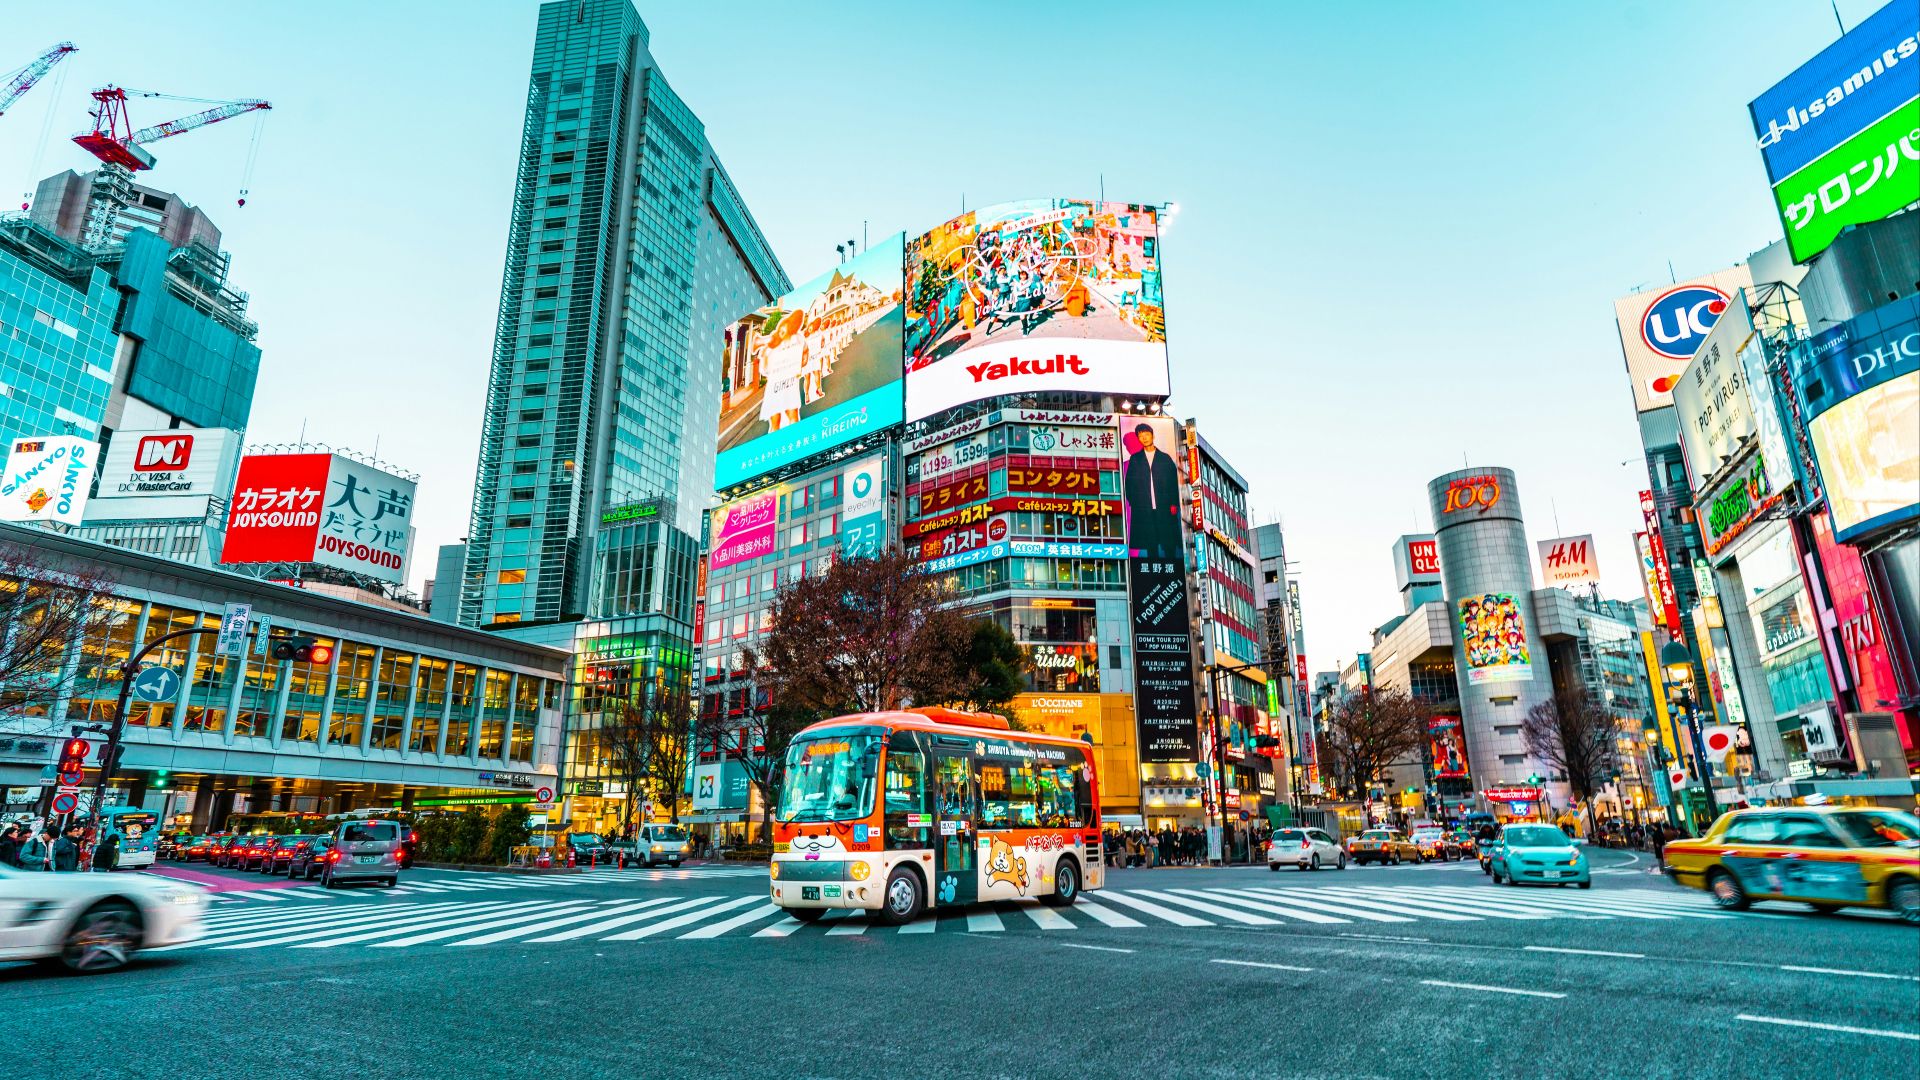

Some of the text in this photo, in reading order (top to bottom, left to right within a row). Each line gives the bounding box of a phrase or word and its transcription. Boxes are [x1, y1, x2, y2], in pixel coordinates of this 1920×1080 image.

[1757, 31, 1920, 149] Hisamits
[1650, 299, 1727, 344] UC
[1811, 330, 1849, 358] Channel
[1695, 342, 1721, 389] 星野源
[1852, 333, 1920, 379] DHC
[965, 354, 1090, 384] Yakult
[1713, 372, 1740, 412] VIRUS
[821, 412, 868, 439] KIREIMO
[1021, 411, 1113, 424] しゃぶしゃぶバイキング
[912, 419, 982, 450] しゃぶしゃぶバイキング
[1060, 432, 1114, 449] しゃぶ葉
[1709, 432, 1719, 449] NOW
[1719, 424, 1727, 437] ON
[139, 440, 187, 466] DC
[955, 443, 988, 465] 1,599円
[2, 446, 67, 496] SANKYO
[130, 473, 147, 482] DC
[149, 472, 171, 481] VISA
[907, 463, 919, 475] 9F
[923, 456, 952, 476] 1,199円
[57, 444, 88, 515] SANKYO
[118, 482, 191, 491] DC MasterCard
[1008, 470, 1096, 488] コンタクト
[237, 487, 321, 511] カラオケ
[327, 473, 411, 521] 大声
[847, 497, 878, 513] eyecity
[922, 478, 987, 510] プライス
[1442, 481, 1501, 515] 109
[740, 497, 774, 517] 品川スキン
[960, 503, 994, 525] ガスト
[1071, 499, 1113, 516] ガスト
[232, 511, 318, 528] JOYSOUND
[740, 510, 770, 528] クリニック
[319, 534, 402, 570] JOYSOUND
[720, 535, 772, 562] 品川美容外科
[942, 528, 984, 556] ガスト
[1014, 544, 1041, 554] AEON
[1048, 544, 1125, 556] 英会話イーオン
[929, 550, 989, 571] 英会話イーオン
[1547, 539, 1587, 569] H&M
[1140, 563, 1174, 573] 星野源
[1152, 592, 1184, 626] NOW ON SALE!
[228, 607, 246, 652] 渋谷駅前
[1035, 654, 1076, 668] Ushi8
[1032, 698, 1083, 708] L'OCCITANE
[987, 744, 1066, 760] SHIBUYA community bus HACHIKO
[1258, 772, 1275, 790] LUSH
[851, 843, 871, 851] D209
[1025, 833, 1065, 852] ハチ公バス
